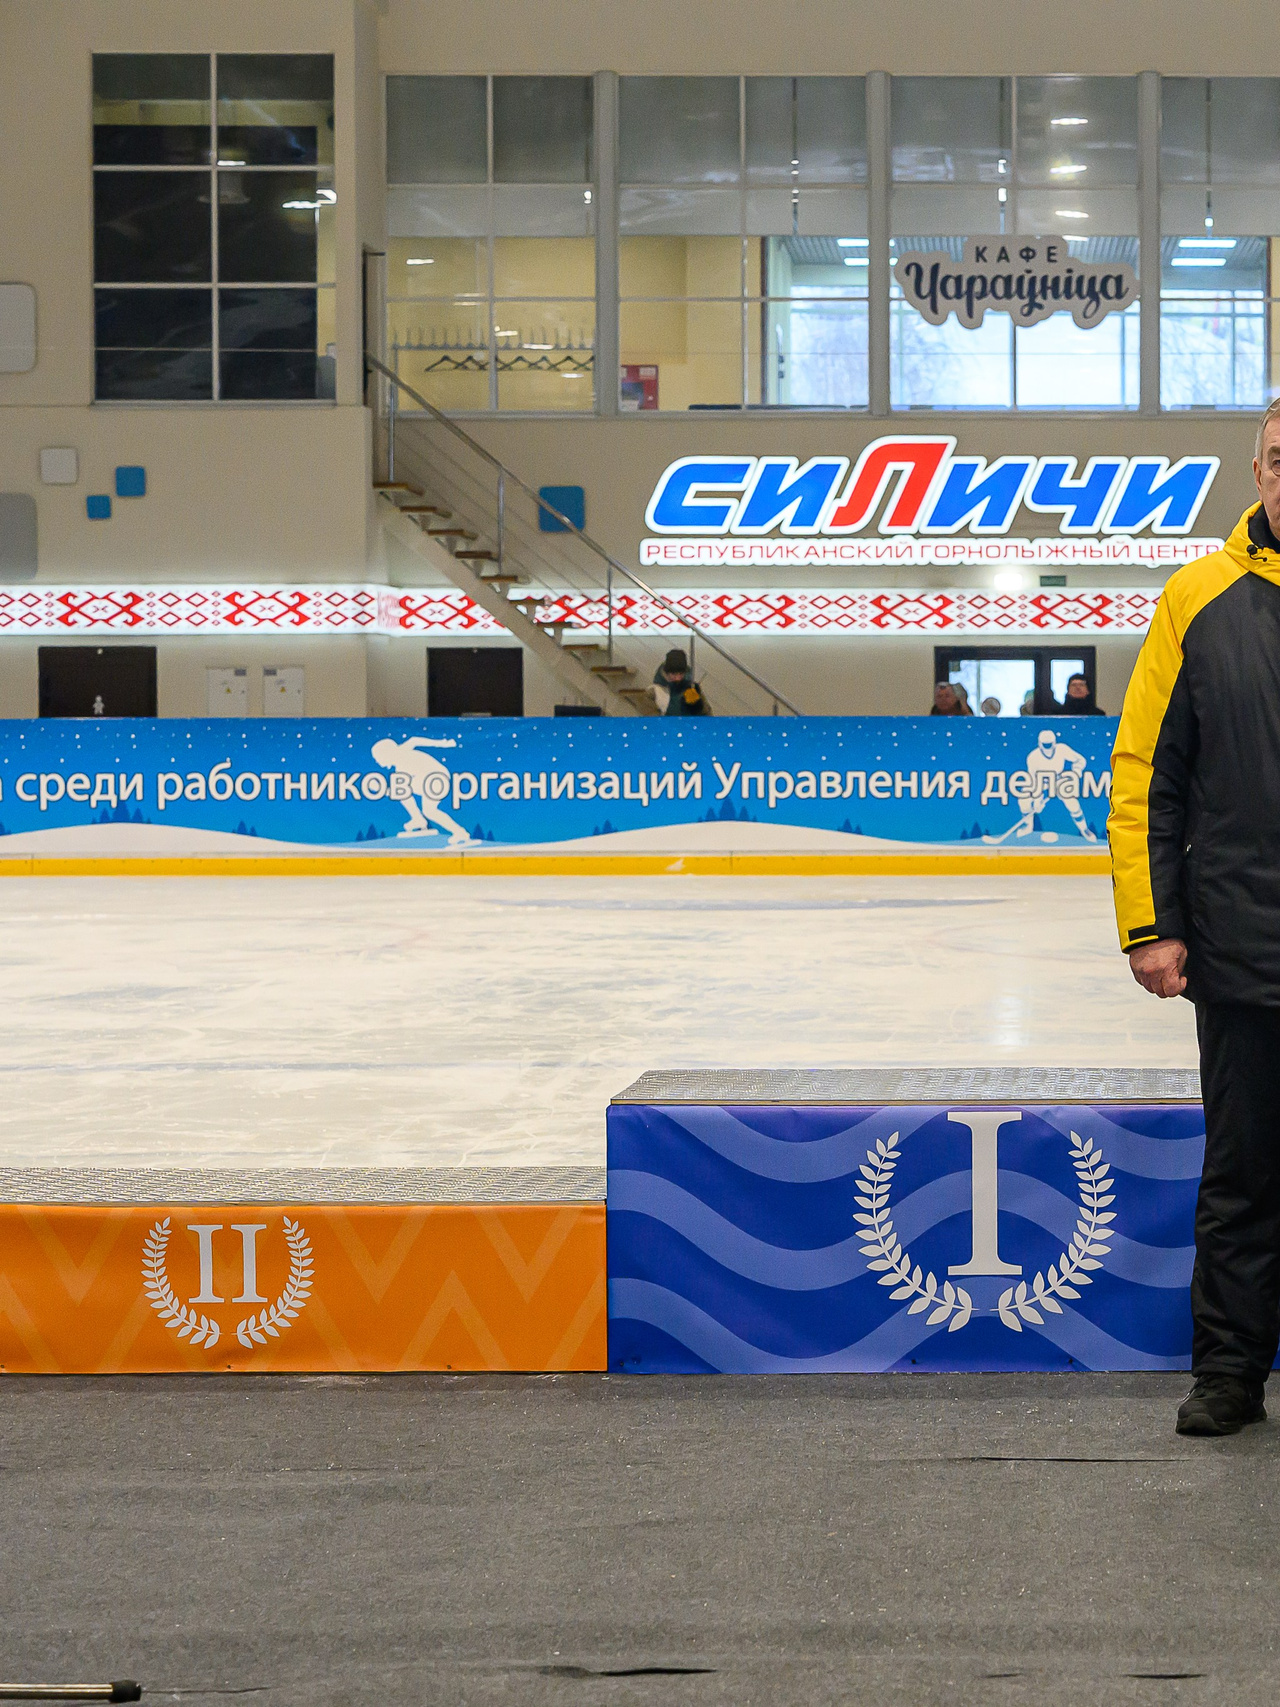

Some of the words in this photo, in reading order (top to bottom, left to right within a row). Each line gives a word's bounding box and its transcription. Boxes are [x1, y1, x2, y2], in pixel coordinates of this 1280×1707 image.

[975, 246, 1058, 263] КАФЕ
[905, 262, 1129, 319] Чараўніца
[646, 541, 913, 559] РЕСПУБЛИКАНСКИЙ
[920, 541, 1130, 559] ГОРНОЛЫЖНЫЙ
[15, 772, 144, 811] среди
[157, 761, 413, 811] работников
[422, 761, 703, 810] организаций
[713, 762, 970, 808] Управления
